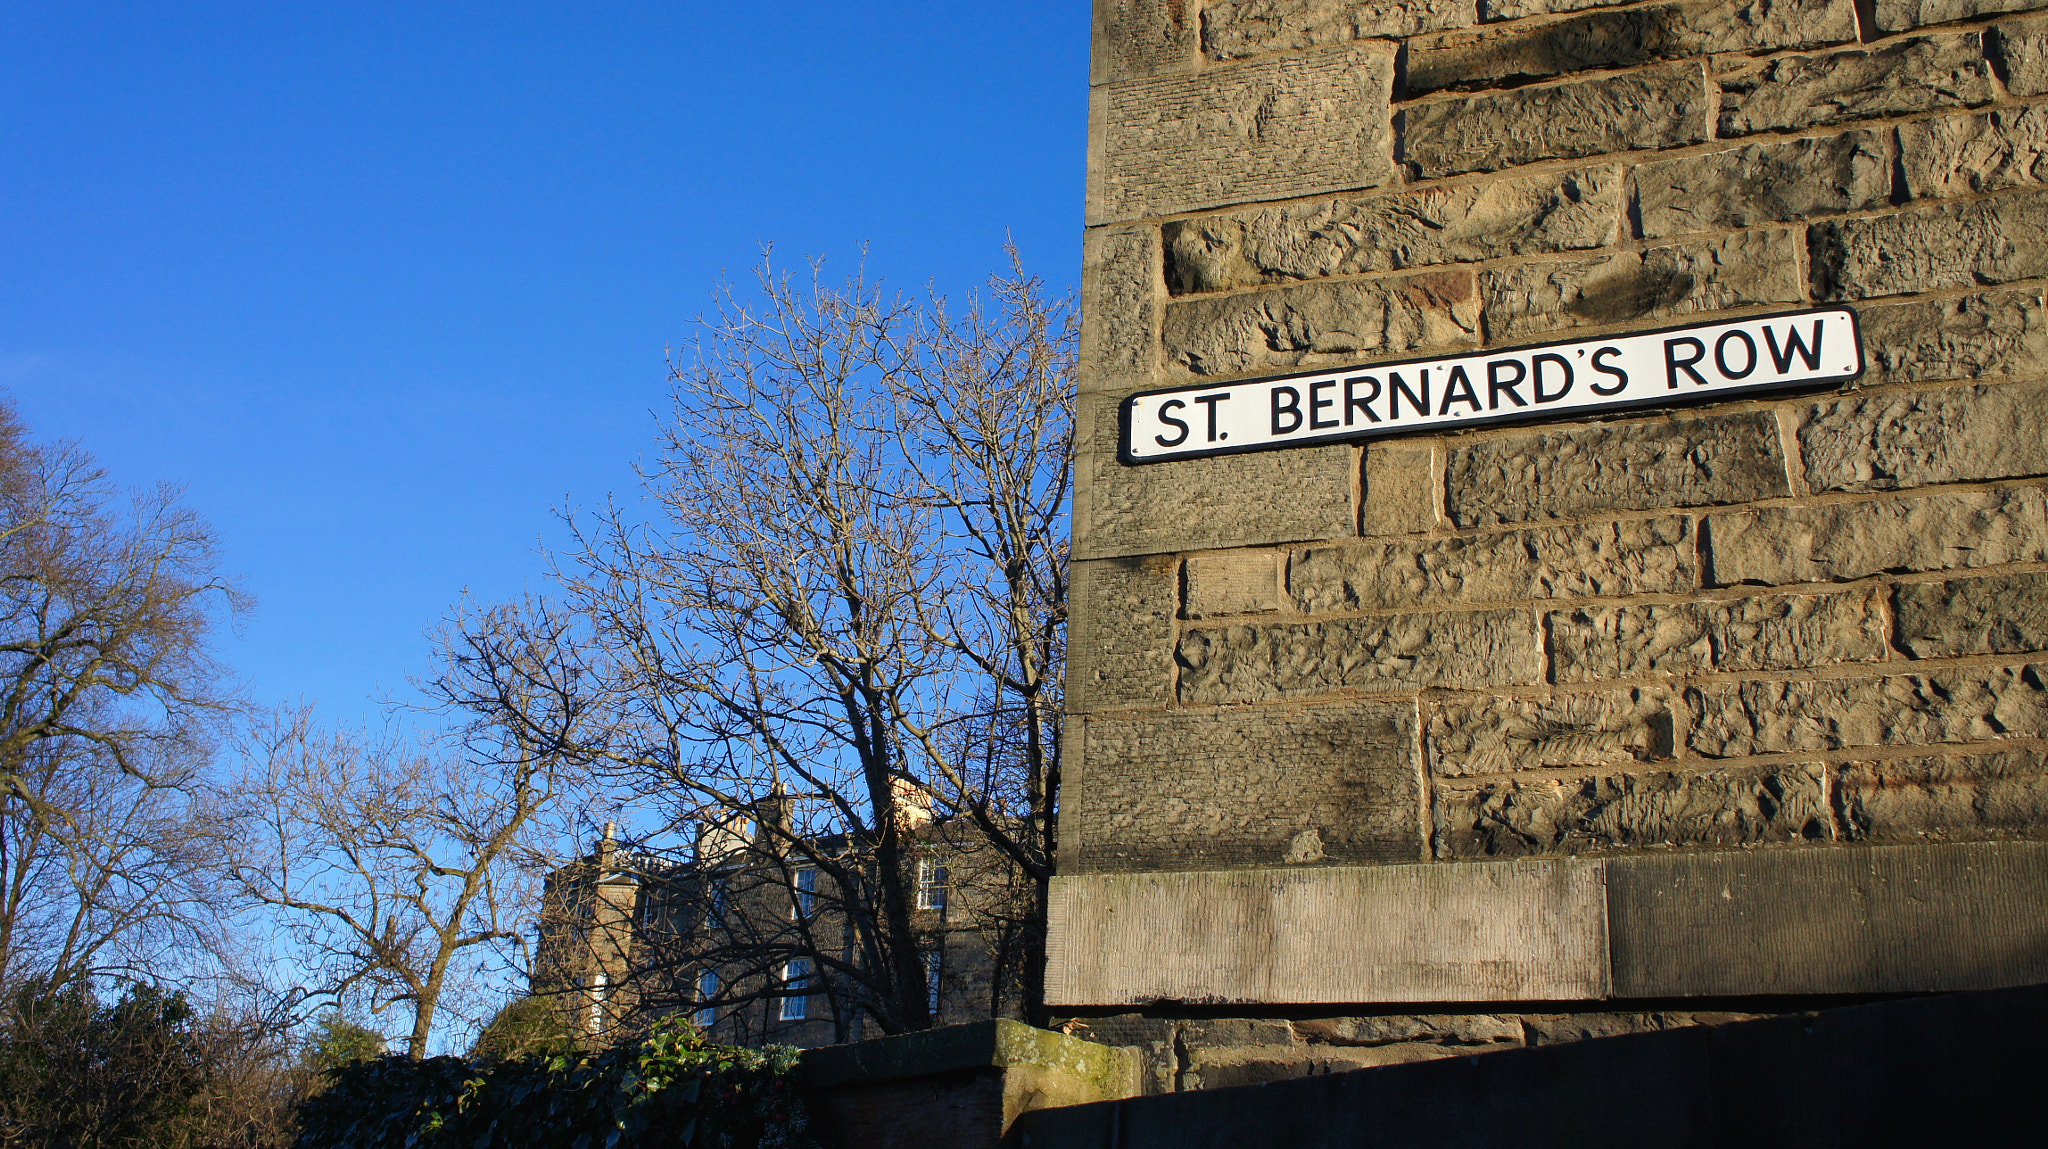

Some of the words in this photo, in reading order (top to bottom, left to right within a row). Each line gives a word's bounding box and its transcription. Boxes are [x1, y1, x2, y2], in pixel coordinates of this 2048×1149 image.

[1155, 393, 1230, 447] ST.
[1271, 347, 1628, 435] BERNARD'S
[1664, 320, 1823, 389] ROW
